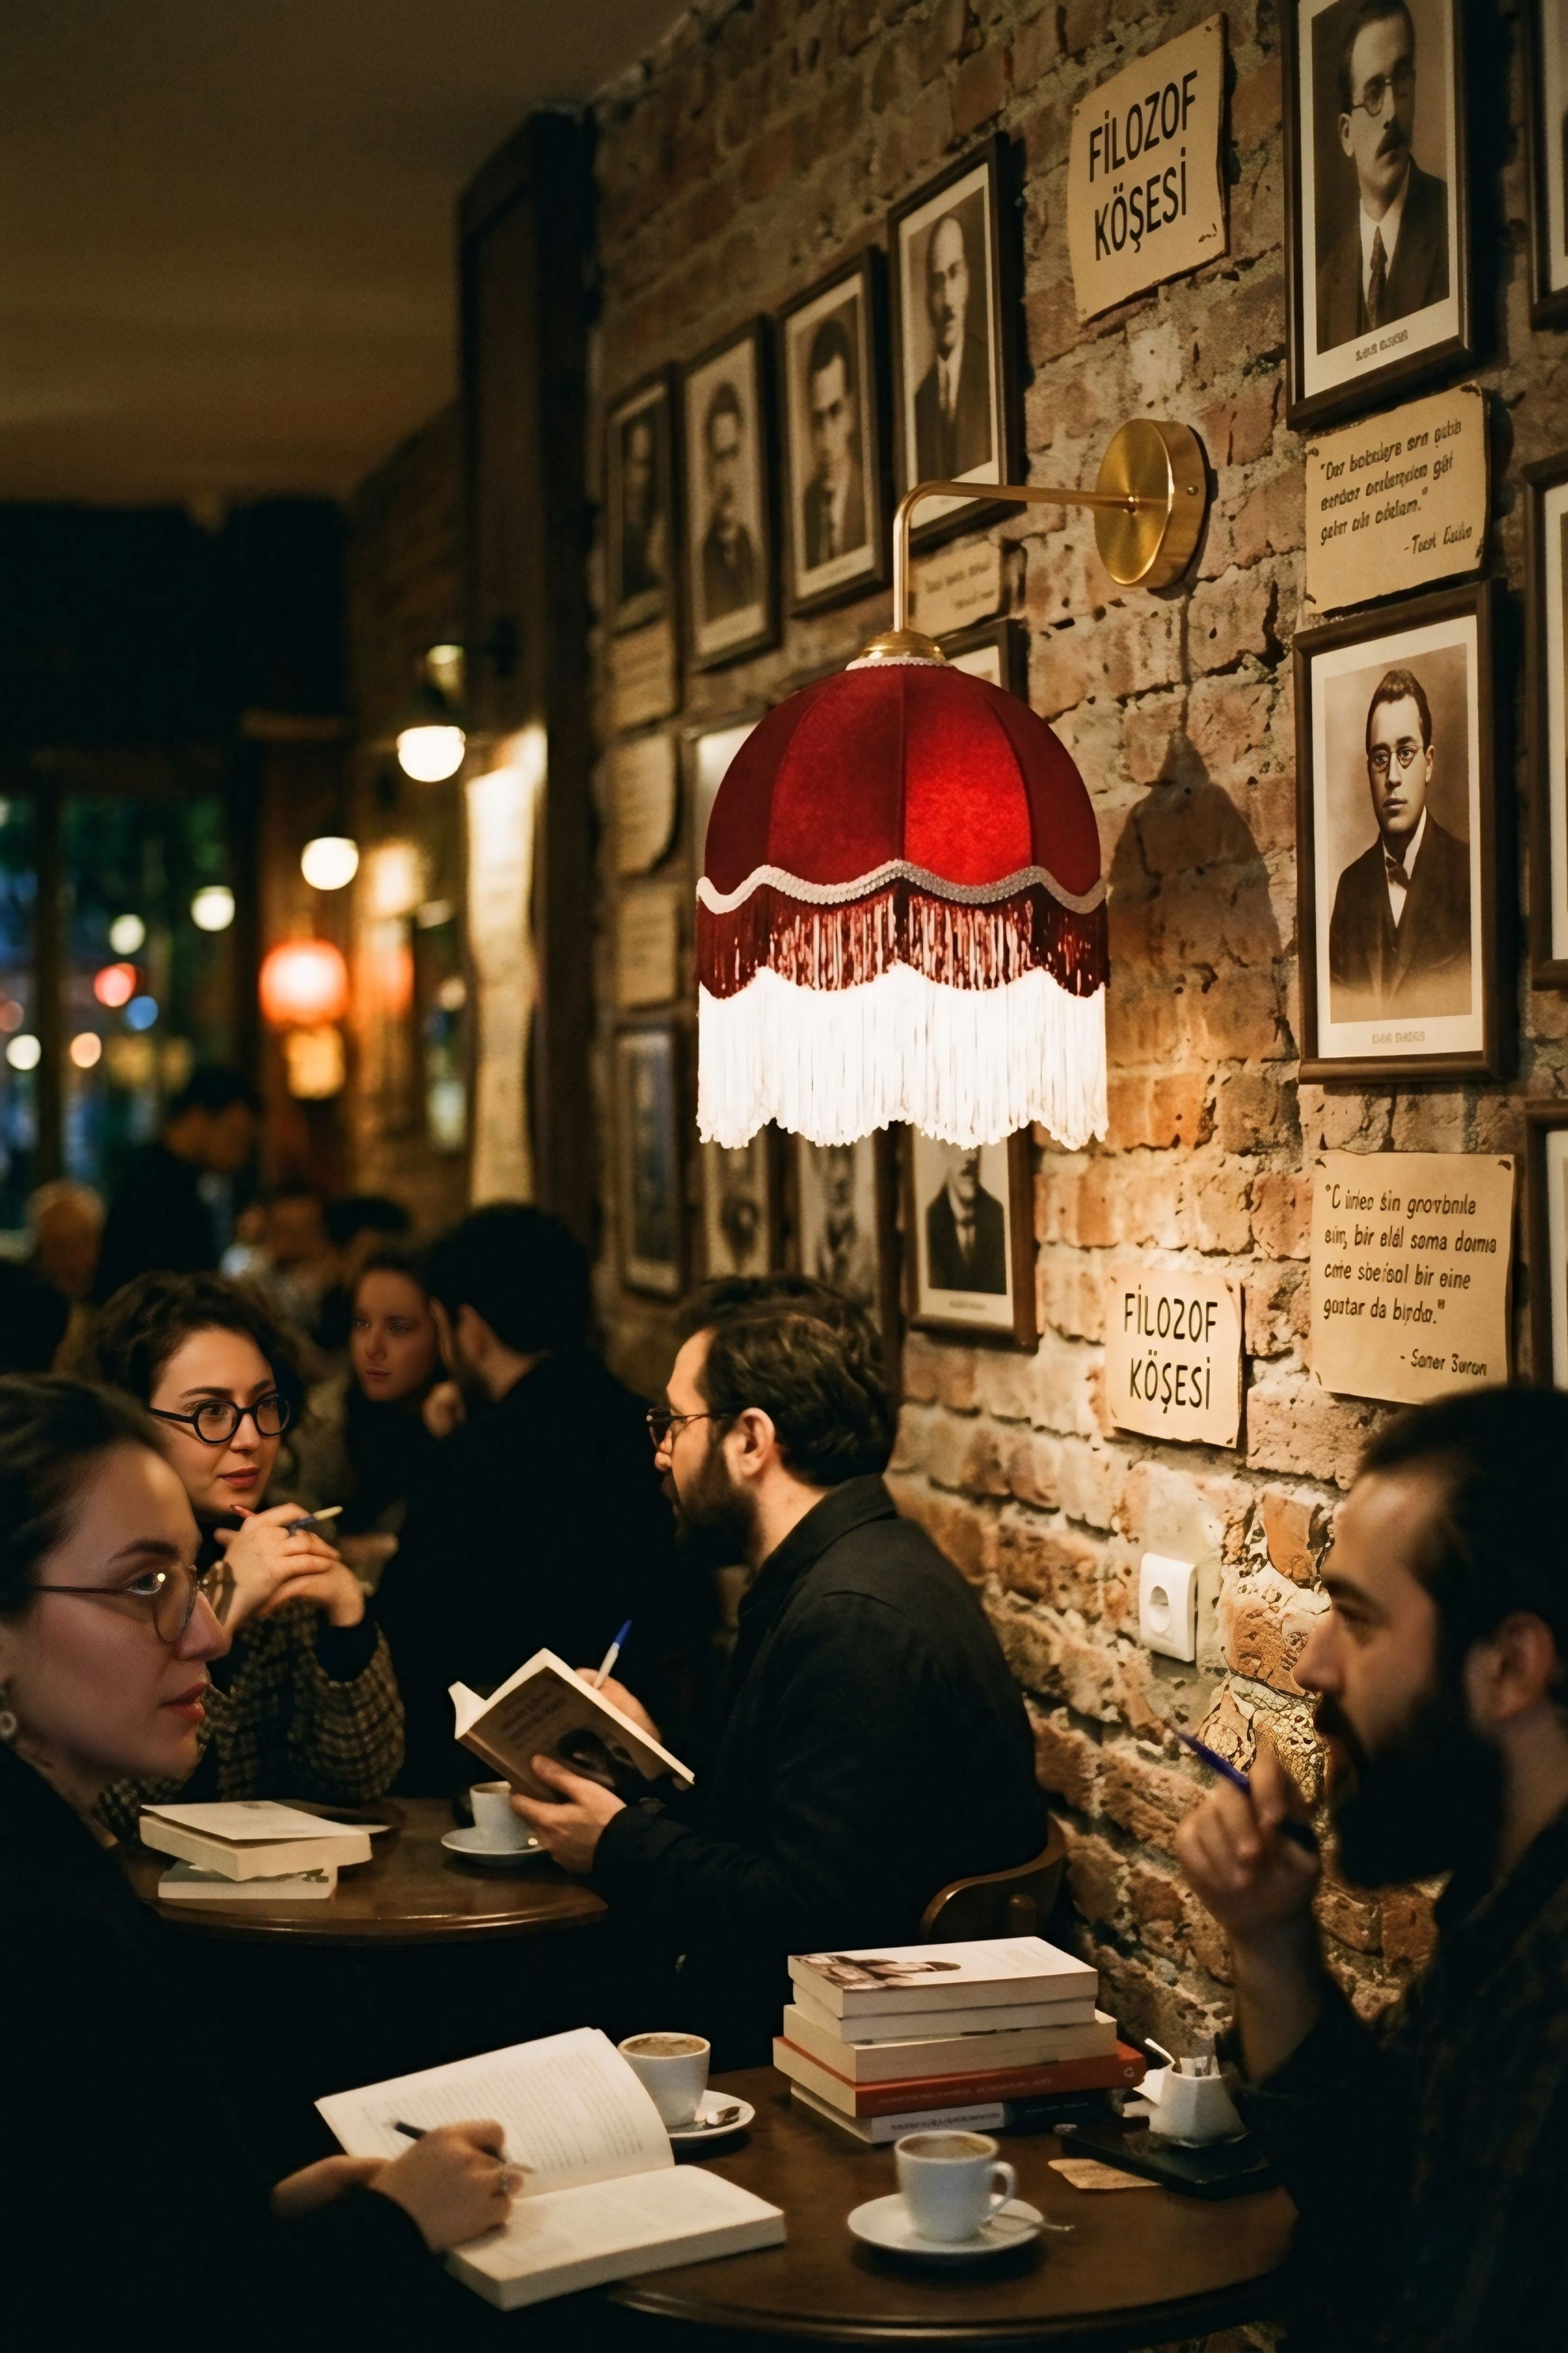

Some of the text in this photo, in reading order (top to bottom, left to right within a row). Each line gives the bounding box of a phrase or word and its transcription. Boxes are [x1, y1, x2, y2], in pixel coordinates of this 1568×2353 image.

[1089, 69, 1198, 183] FİLOZOF
[1094, 146, 1187, 262] KÖŞESİ
[1414, 1262, 1435, 1286] bir
[1123, 1283, 1218, 1344] FİLOZOF
[1129, 1349, 1211, 1415] KÖŞESİ
